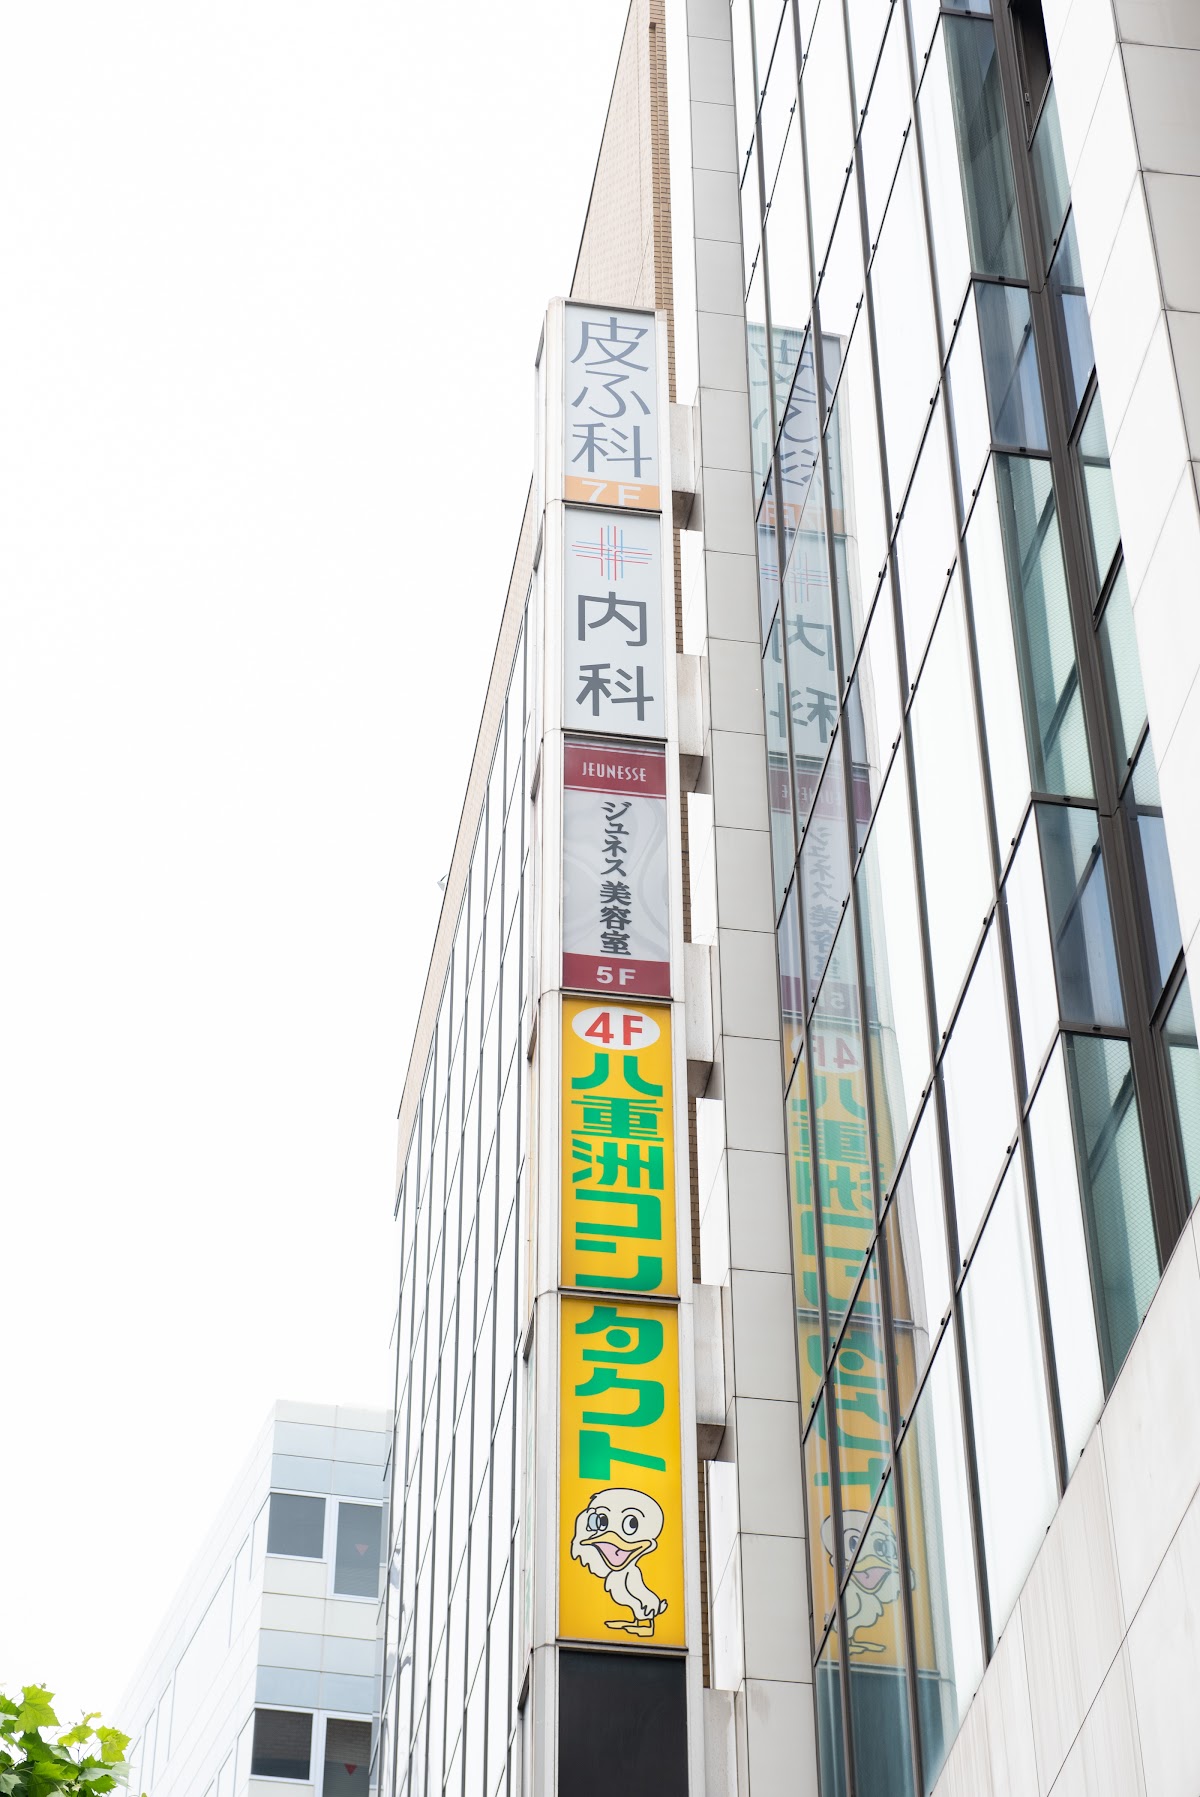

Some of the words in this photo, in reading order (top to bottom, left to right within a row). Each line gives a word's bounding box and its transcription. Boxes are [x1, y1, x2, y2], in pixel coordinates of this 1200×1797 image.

[571, 317, 652, 479] 皮ふ科
[576, 592, 654, 721] 内科
[582, 762, 647, 782] JEUNESSE
[596, 965, 636, 986] 5F
[584, 1011, 643, 1046] 4F
[571, 1053, 666, 1481] 八重洲コンタクト
